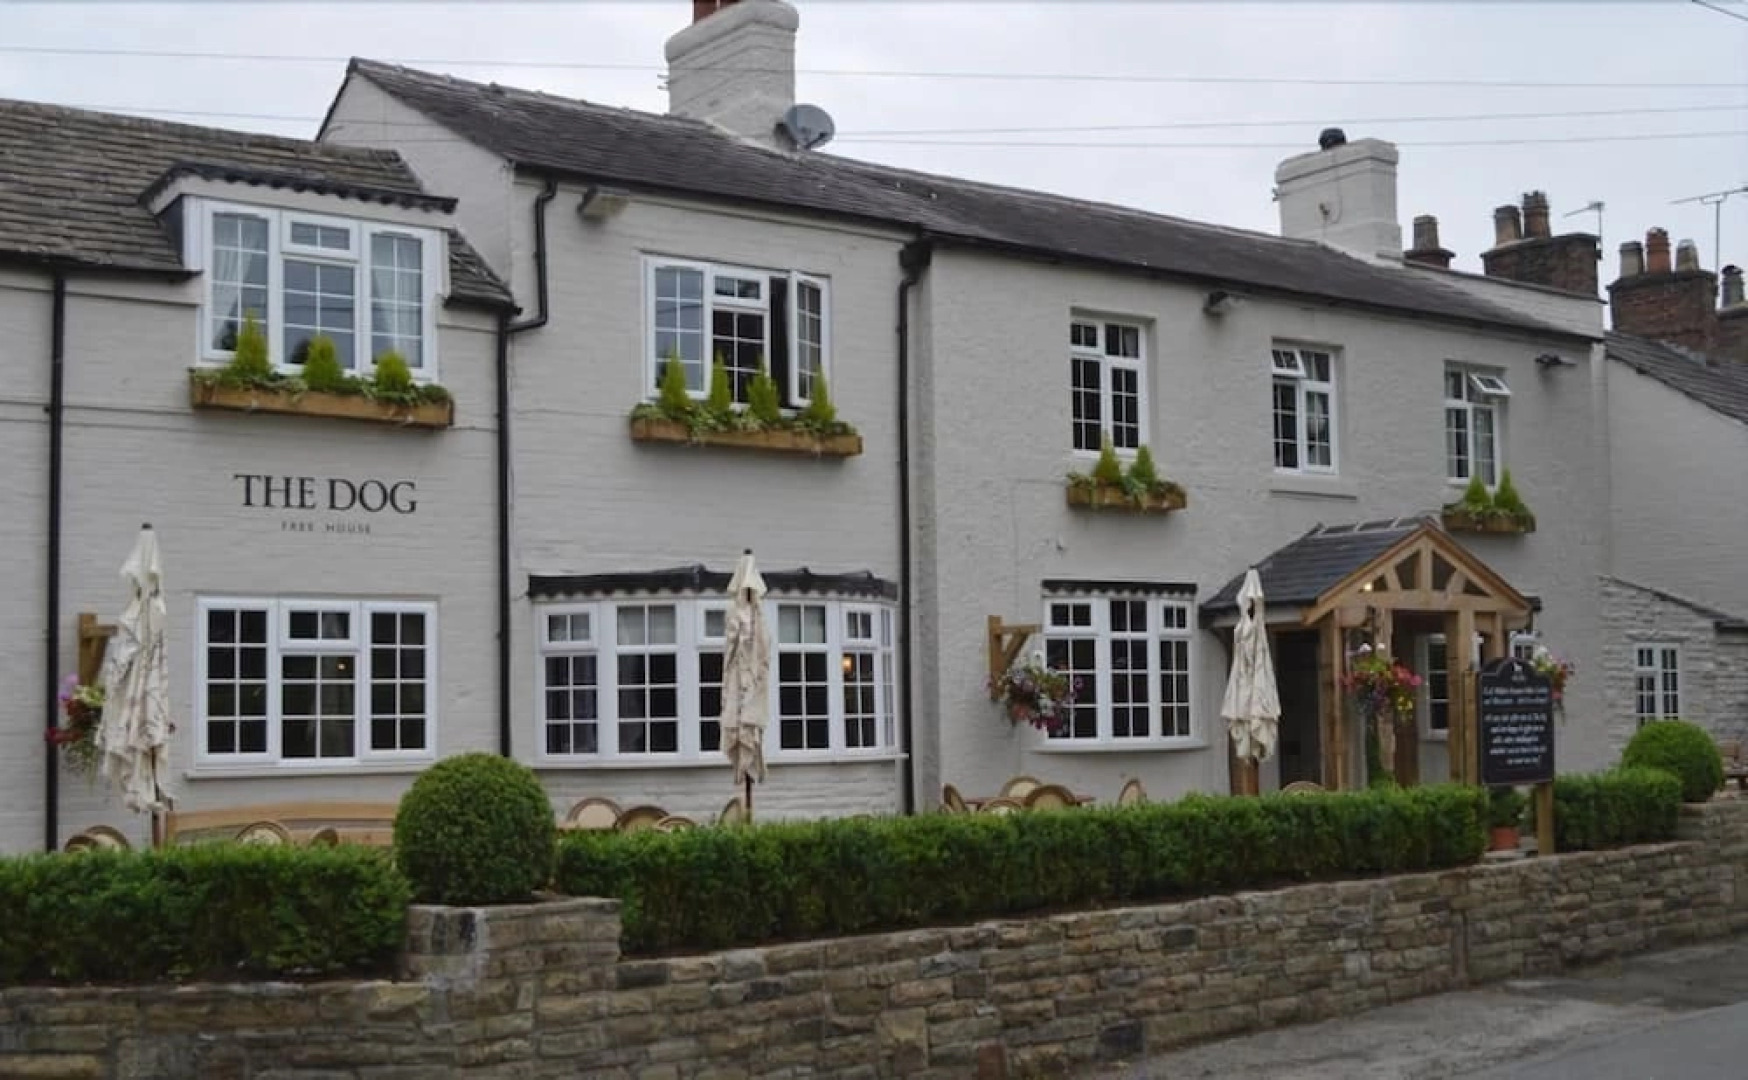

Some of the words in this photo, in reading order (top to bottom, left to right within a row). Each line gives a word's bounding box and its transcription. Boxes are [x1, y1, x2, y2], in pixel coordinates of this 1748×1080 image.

[234, 474, 316, 509] THE
[327, 478, 417, 514] DOG
[281, 521, 314, 532] FREE
[325, 523, 371, 534] HOUSE
